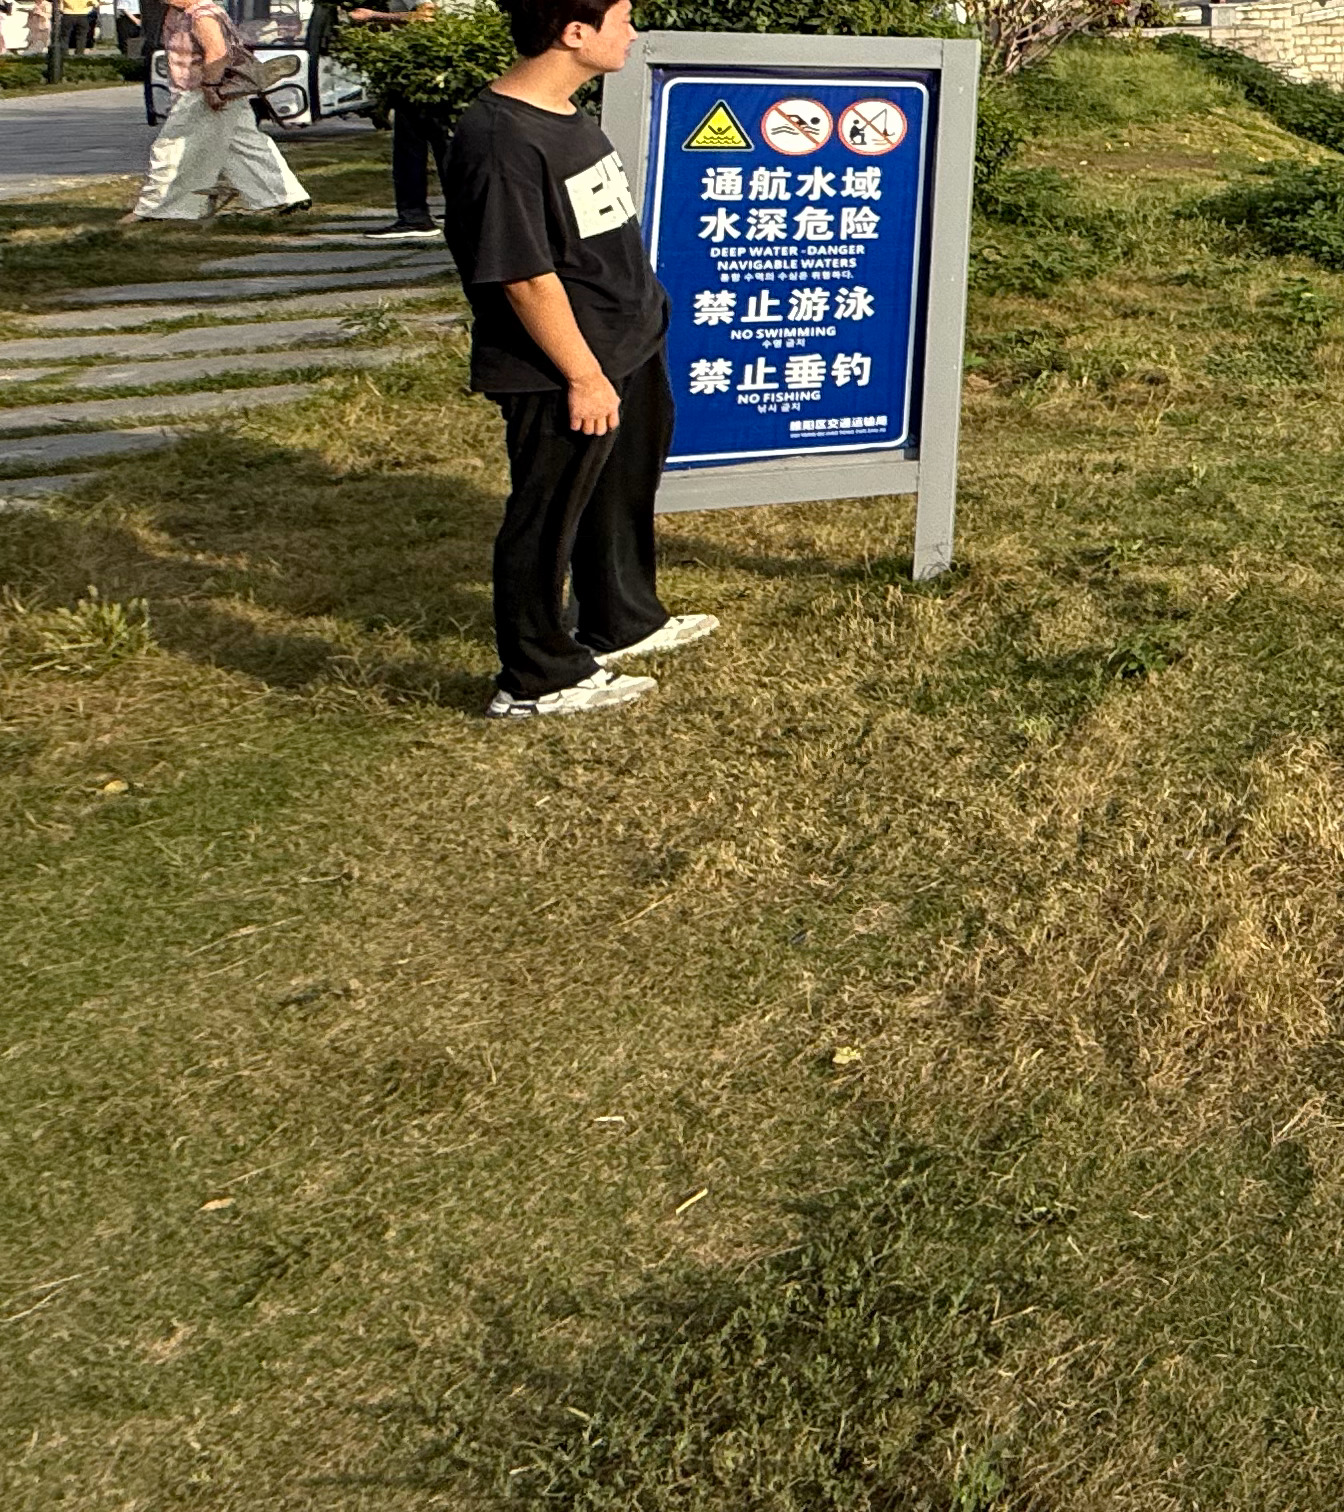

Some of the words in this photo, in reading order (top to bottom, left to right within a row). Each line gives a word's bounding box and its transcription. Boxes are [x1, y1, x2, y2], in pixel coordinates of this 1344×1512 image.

[701, 166, 882, 201] 通航水域
[698, 206, 881, 243] 水深危险
[710, 247, 746, 258] DEEP
[749, 246, 798, 257] WATER
[717, 259, 798, 271] NAVIGABLE
[800, 257, 857, 269] WATERS
[693, 285, 875, 326] 禁止游泳
[730, 329, 753, 340] NO
[755, 326, 837, 339] SWIMMING
[689, 352, 872, 395] 禁止垂钓
[737, 393, 760, 405] NO
[763, 390, 821, 403] FISHING
